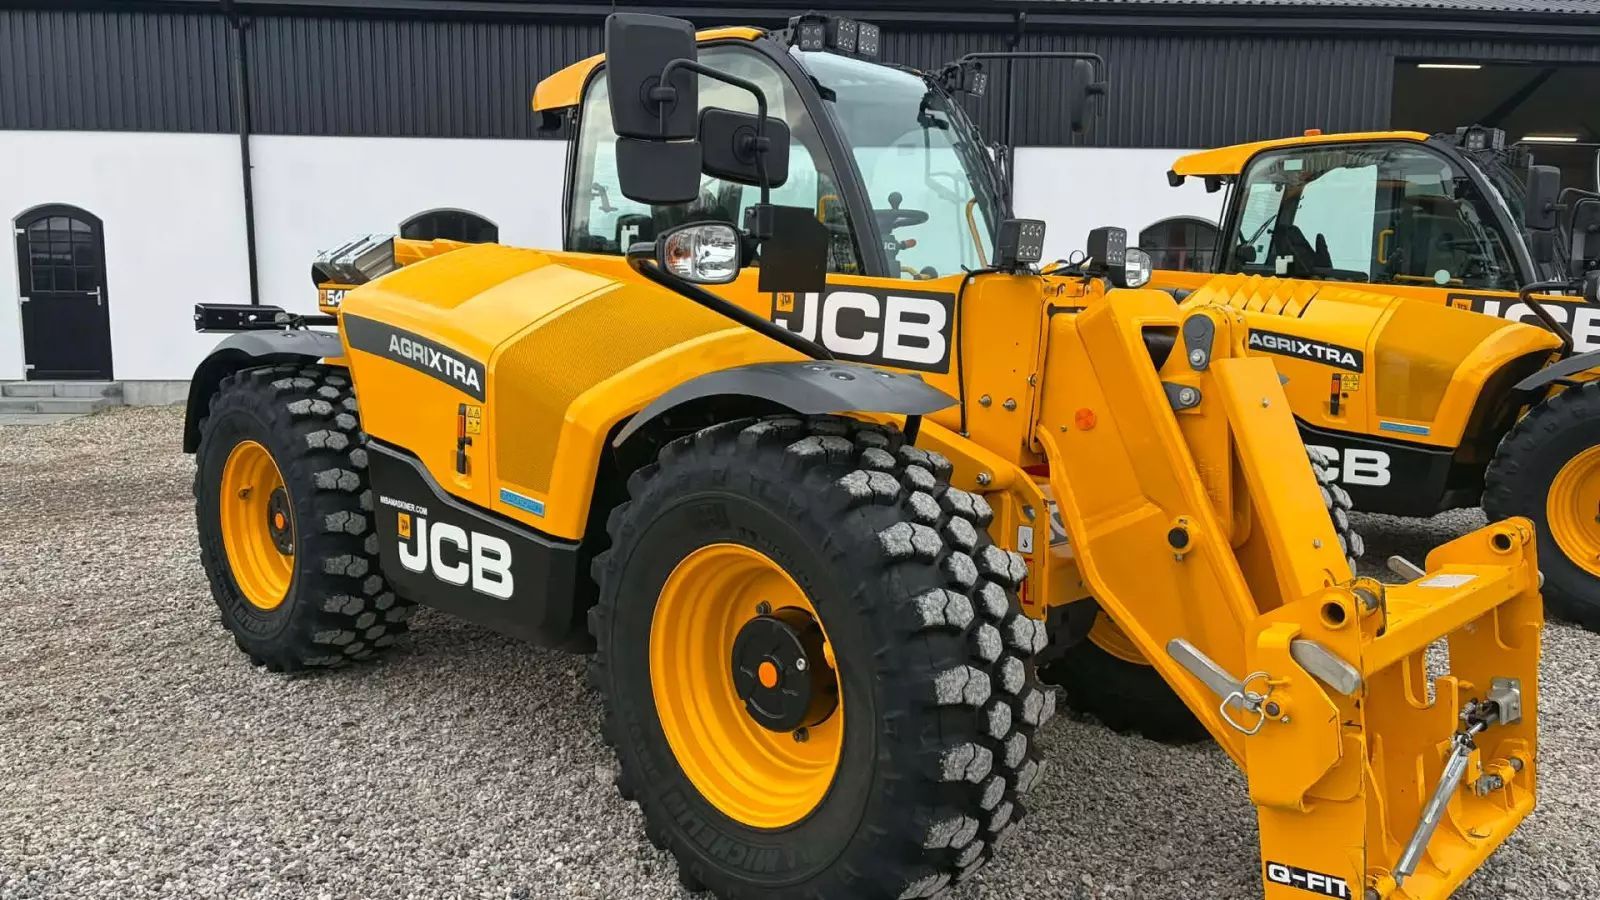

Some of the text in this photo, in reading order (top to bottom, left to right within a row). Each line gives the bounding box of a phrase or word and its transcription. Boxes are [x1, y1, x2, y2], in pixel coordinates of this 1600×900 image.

[327, 290, 350, 306] 54
[775, 291, 947, 364] JCB
[389, 334, 480, 392] AGRIXTRA
[1249, 333, 1357, 367] AGRIXTRA
[1305, 444, 1391, 486] CB
[398, 517, 514, 600] JCB
[1268, 864, 1346, 897] Q-FIT
